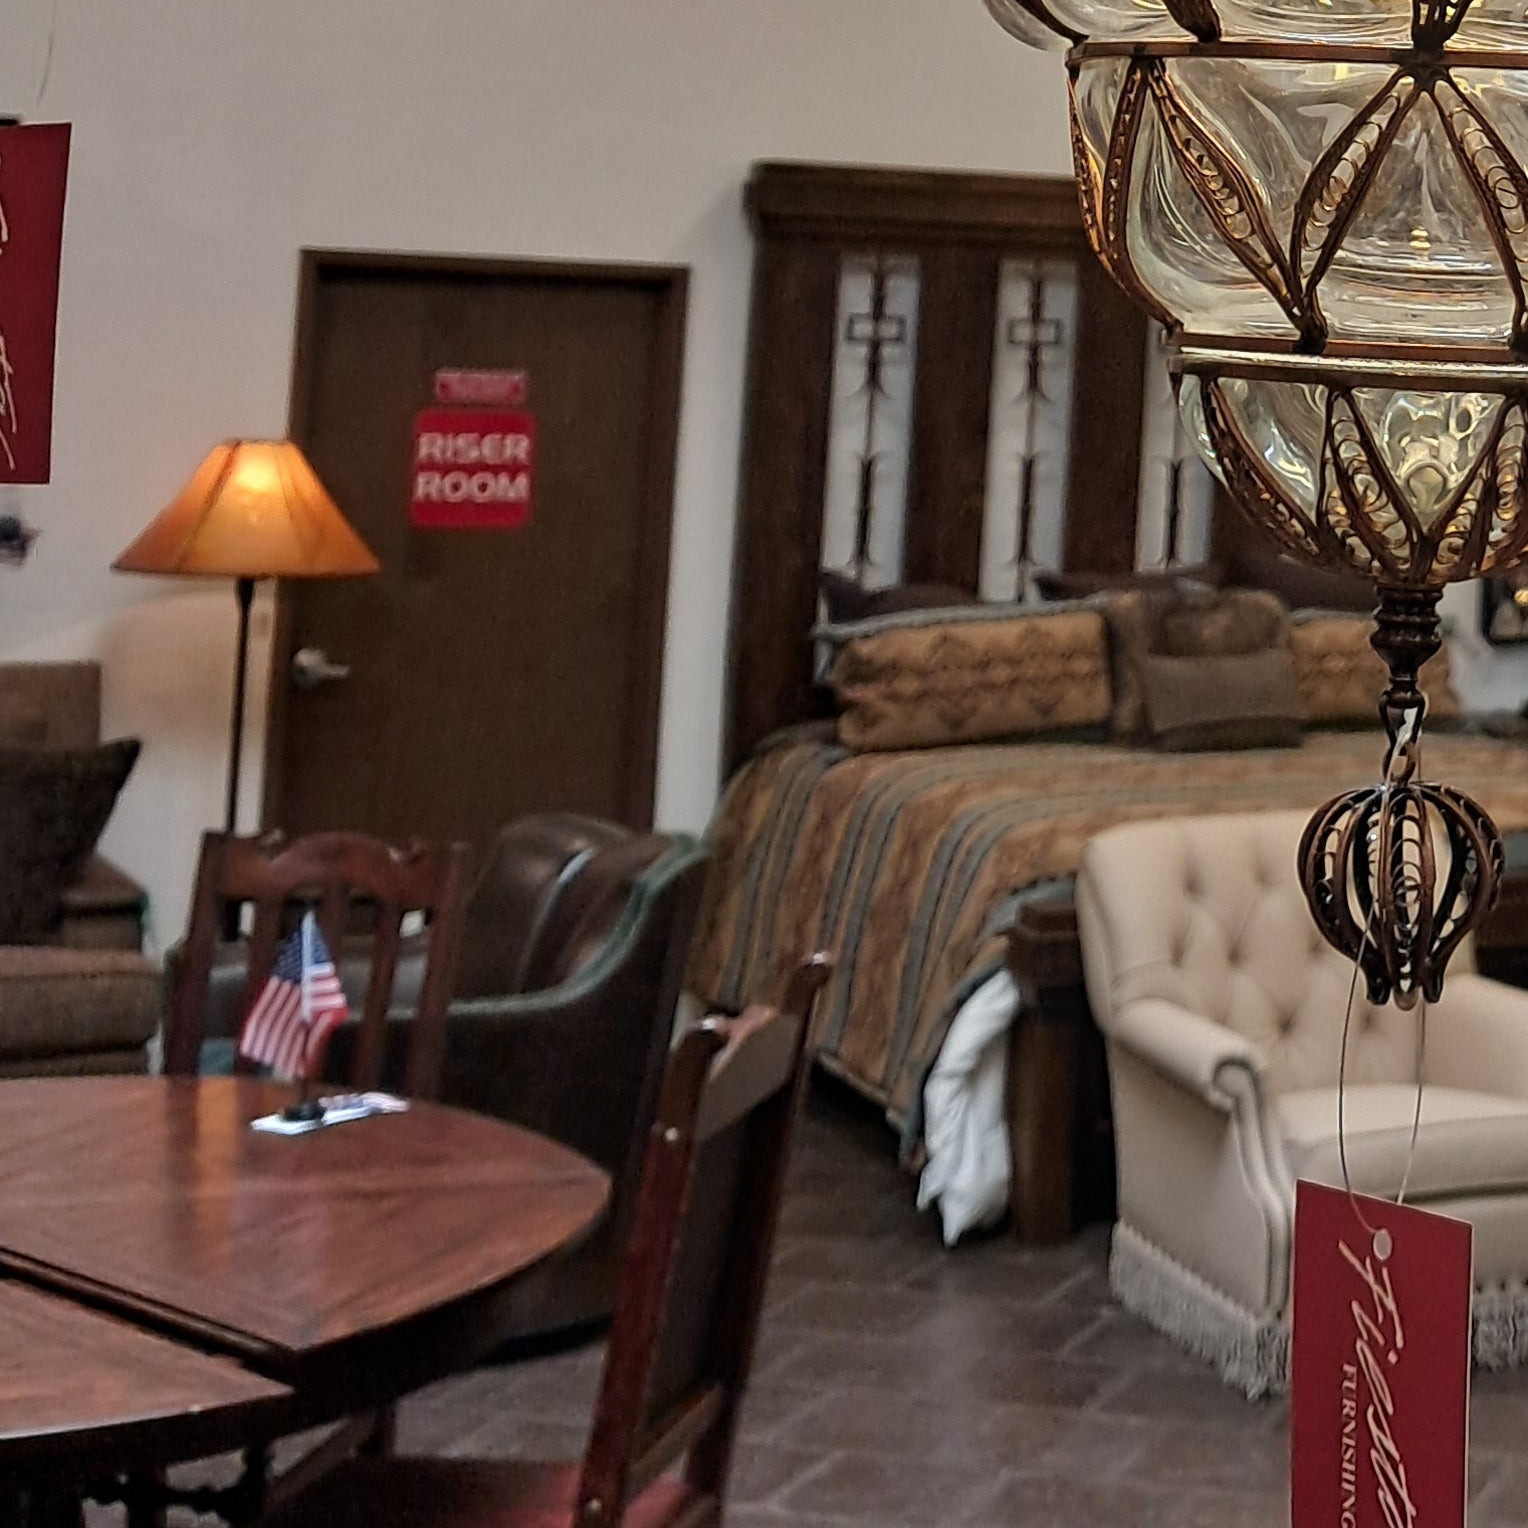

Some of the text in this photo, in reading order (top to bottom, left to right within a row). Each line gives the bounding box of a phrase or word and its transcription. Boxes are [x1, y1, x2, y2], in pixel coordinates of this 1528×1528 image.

[416, 432, 531, 466] RISER
[415, 470, 530, 503] ROOM
[1340, 1362, 1359, 1528] FURNISHING
